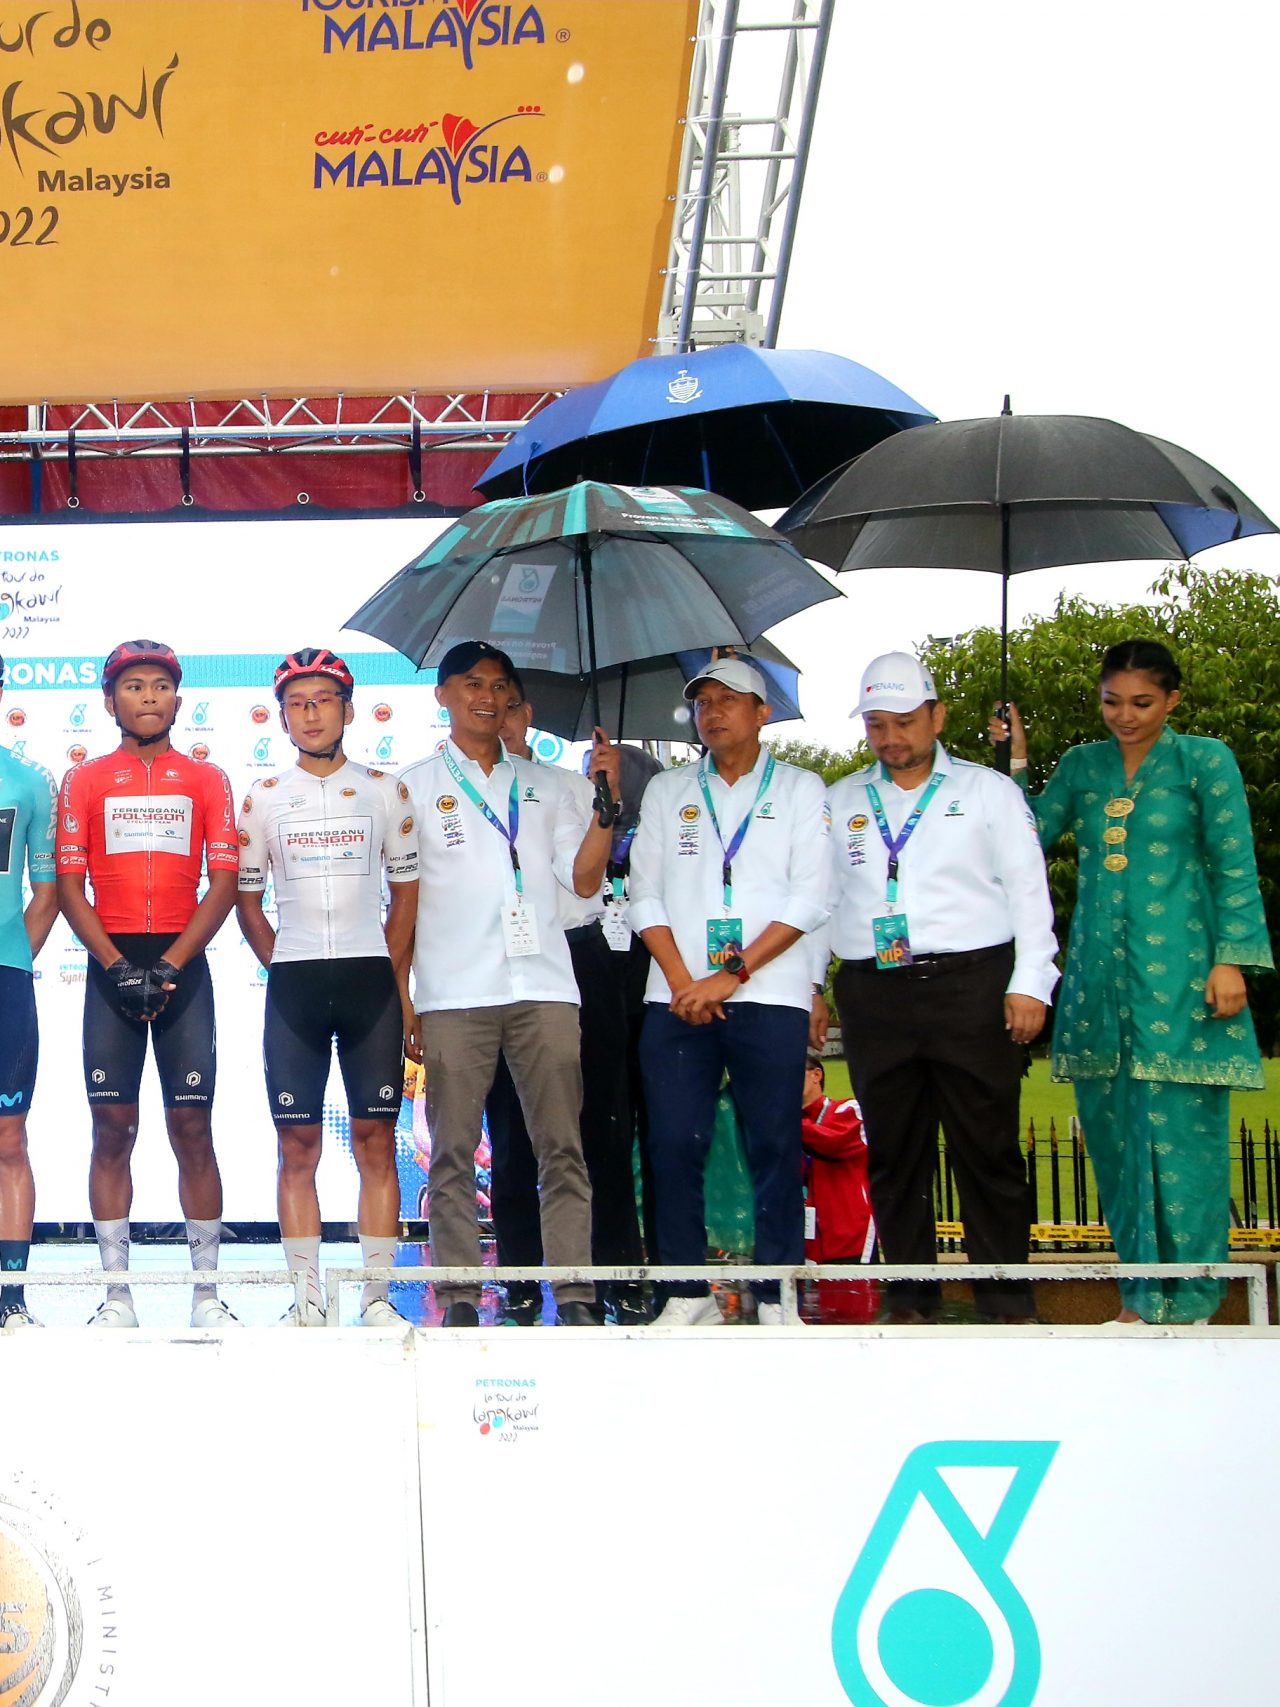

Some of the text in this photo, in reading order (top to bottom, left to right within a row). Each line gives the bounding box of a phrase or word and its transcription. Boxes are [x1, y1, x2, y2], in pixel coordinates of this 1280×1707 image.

[323, 4, 545, 70] MALAYSIA
[37, 166, 170, 197] Malaysia
[314, 145, 532, 205] MALAYSIA
[64, 757, 101, 808] PROTO
[111, 813, 185, 823] POLYGON
[287, 829, 365, 838] TERENGGANU
[287, 834, 365, 846] POLYGON
[877, 949, 904, 964] VIP
[476, 1379, 536, 1388] PETRONAS
[89, 1585, 118, 1707] MINIST
